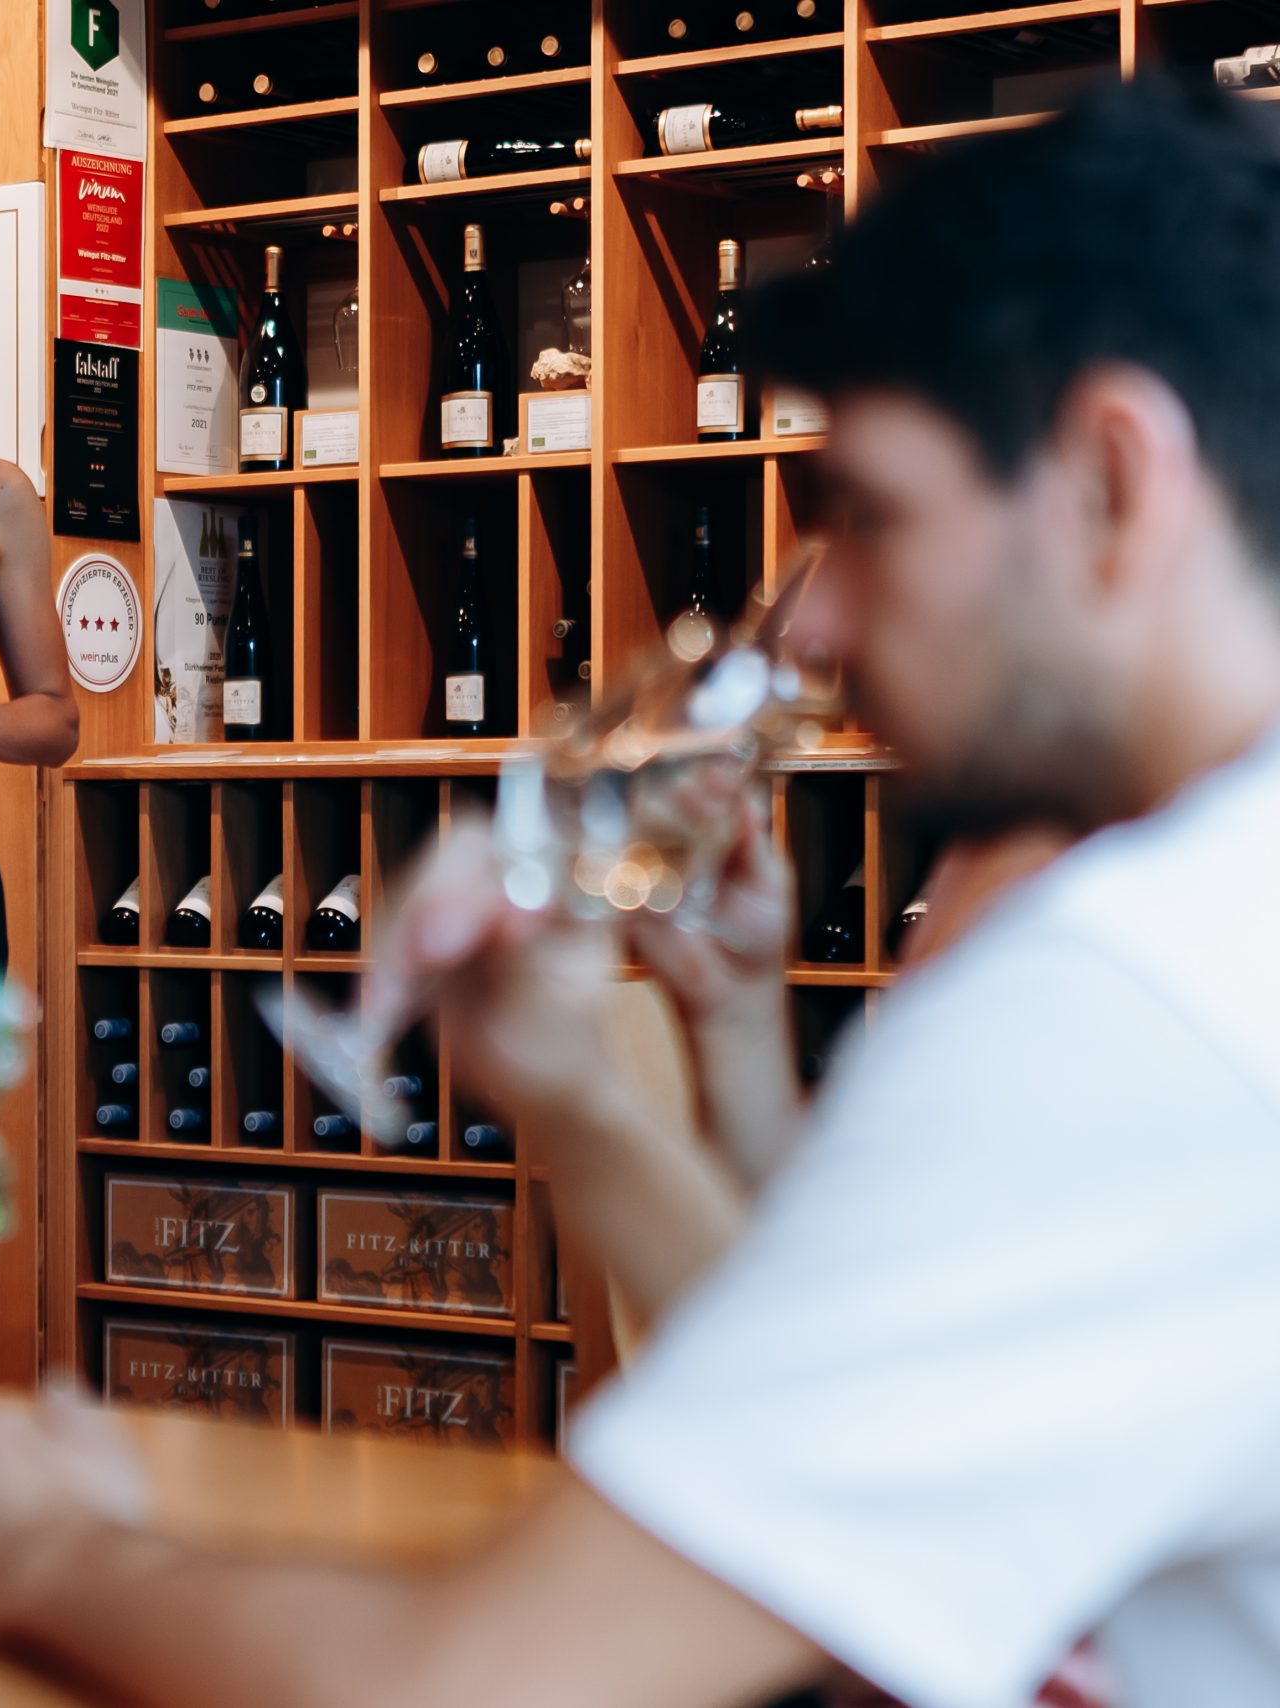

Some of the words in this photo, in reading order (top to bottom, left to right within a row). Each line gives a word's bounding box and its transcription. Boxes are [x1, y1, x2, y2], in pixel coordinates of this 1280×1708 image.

[88, 8, 101, 47] F
[71, 156, 132, 175] AUSZEICHNUNG
[86, 203, 118, 215] WEINGUIDE
[82, 212, 123, 225] DEUTSCHLAND
[77, 248, 100, 260] Weingut
[75, 351, 120, 380] falstaff
[191, 418, 207, 429] 2021
[200, 566, 216, 575] BEST
[66, 568, 111, 626] KLASSIFIZIERTER
[112, 575, 134, 631] ERZEUGER
[194, 612, 204, 625] 90
[80, 651, 118, 664] wein.plus
[184, 663, 213, 672] Dürkheimer
[160, 1217, 240, 1253] FITZ
[346, 1233, 490, 1259] FITZ-RITTER
[129, 1361, 262, 1388] FITZ-RITTER
[383, 1385, 470, 1427] FITZ
